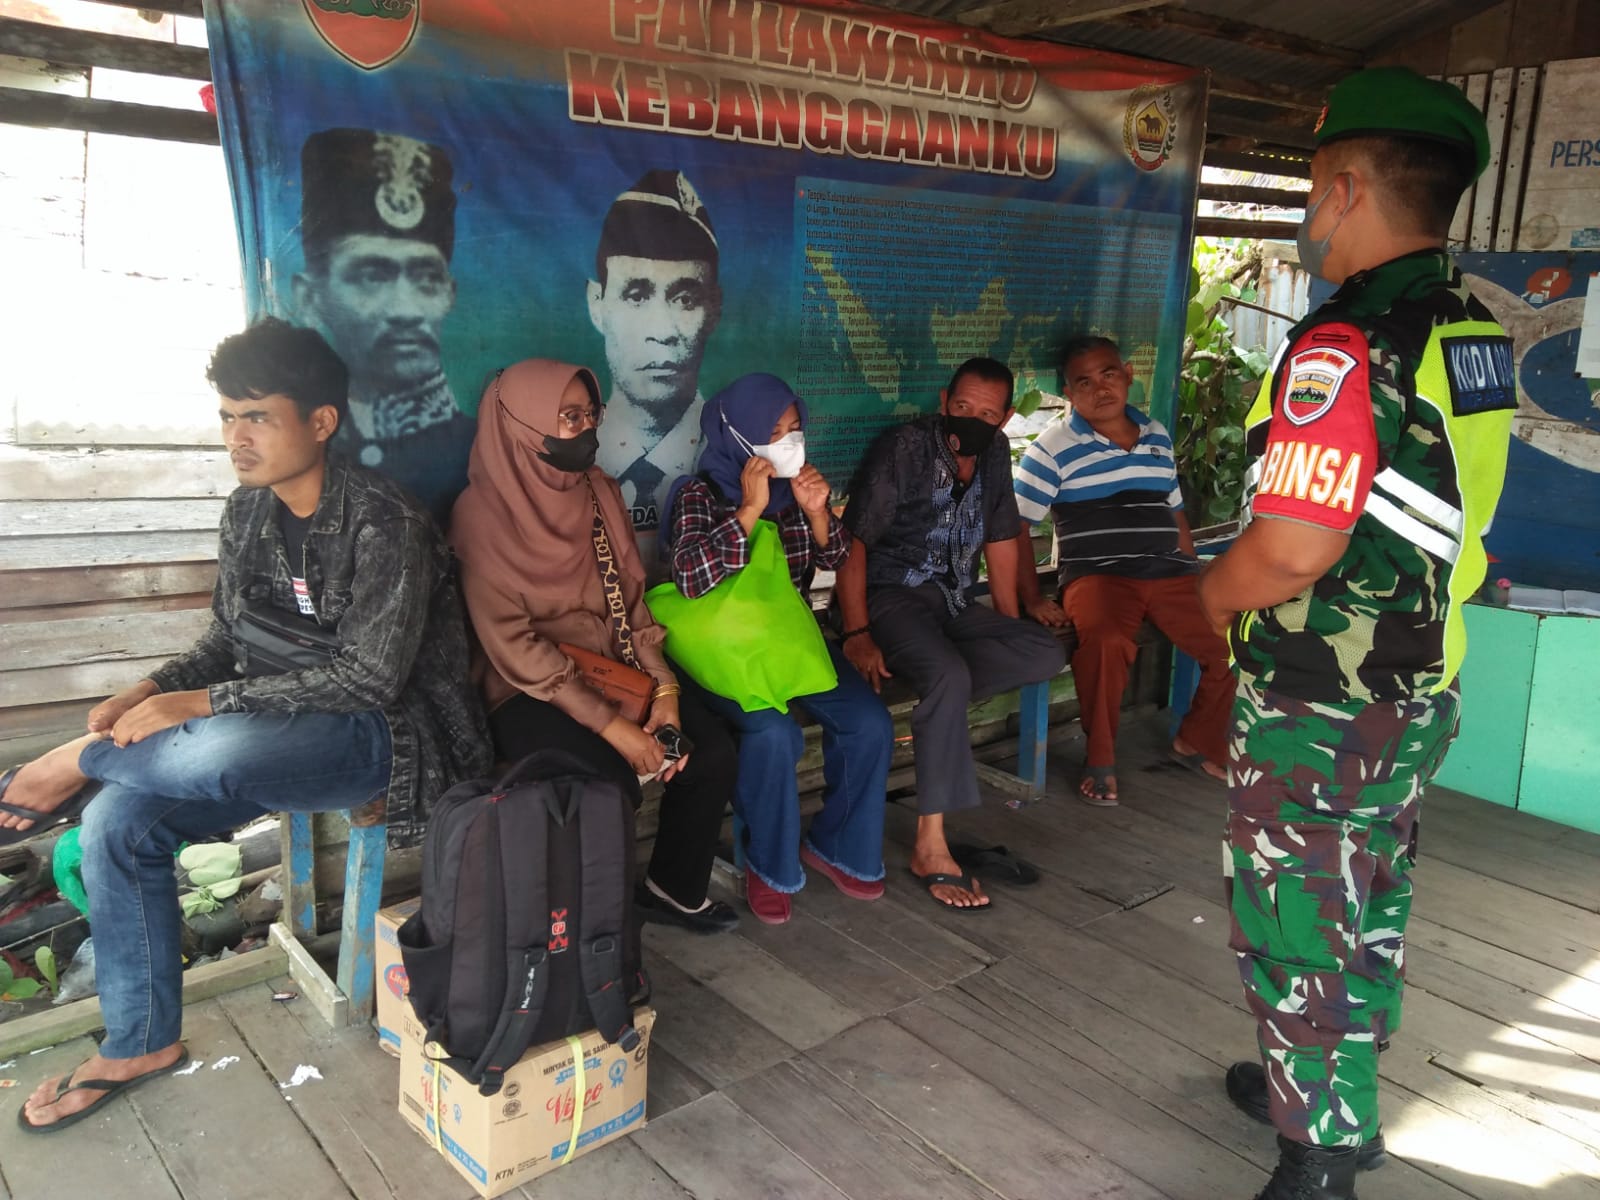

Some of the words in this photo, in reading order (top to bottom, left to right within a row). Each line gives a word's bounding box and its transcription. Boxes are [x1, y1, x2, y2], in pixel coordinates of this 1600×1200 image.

[609, 0, 1038, 110] PAHLAWANKU
[565, 47, 1059, 179] KEBANGGAANKU
[1257, 441, 1362, 512] BINSA
[626, 506, 660, 526] DA
[546, 1083, 603, 1124] Vico
[495, 1167, 515, 1181] KTN
